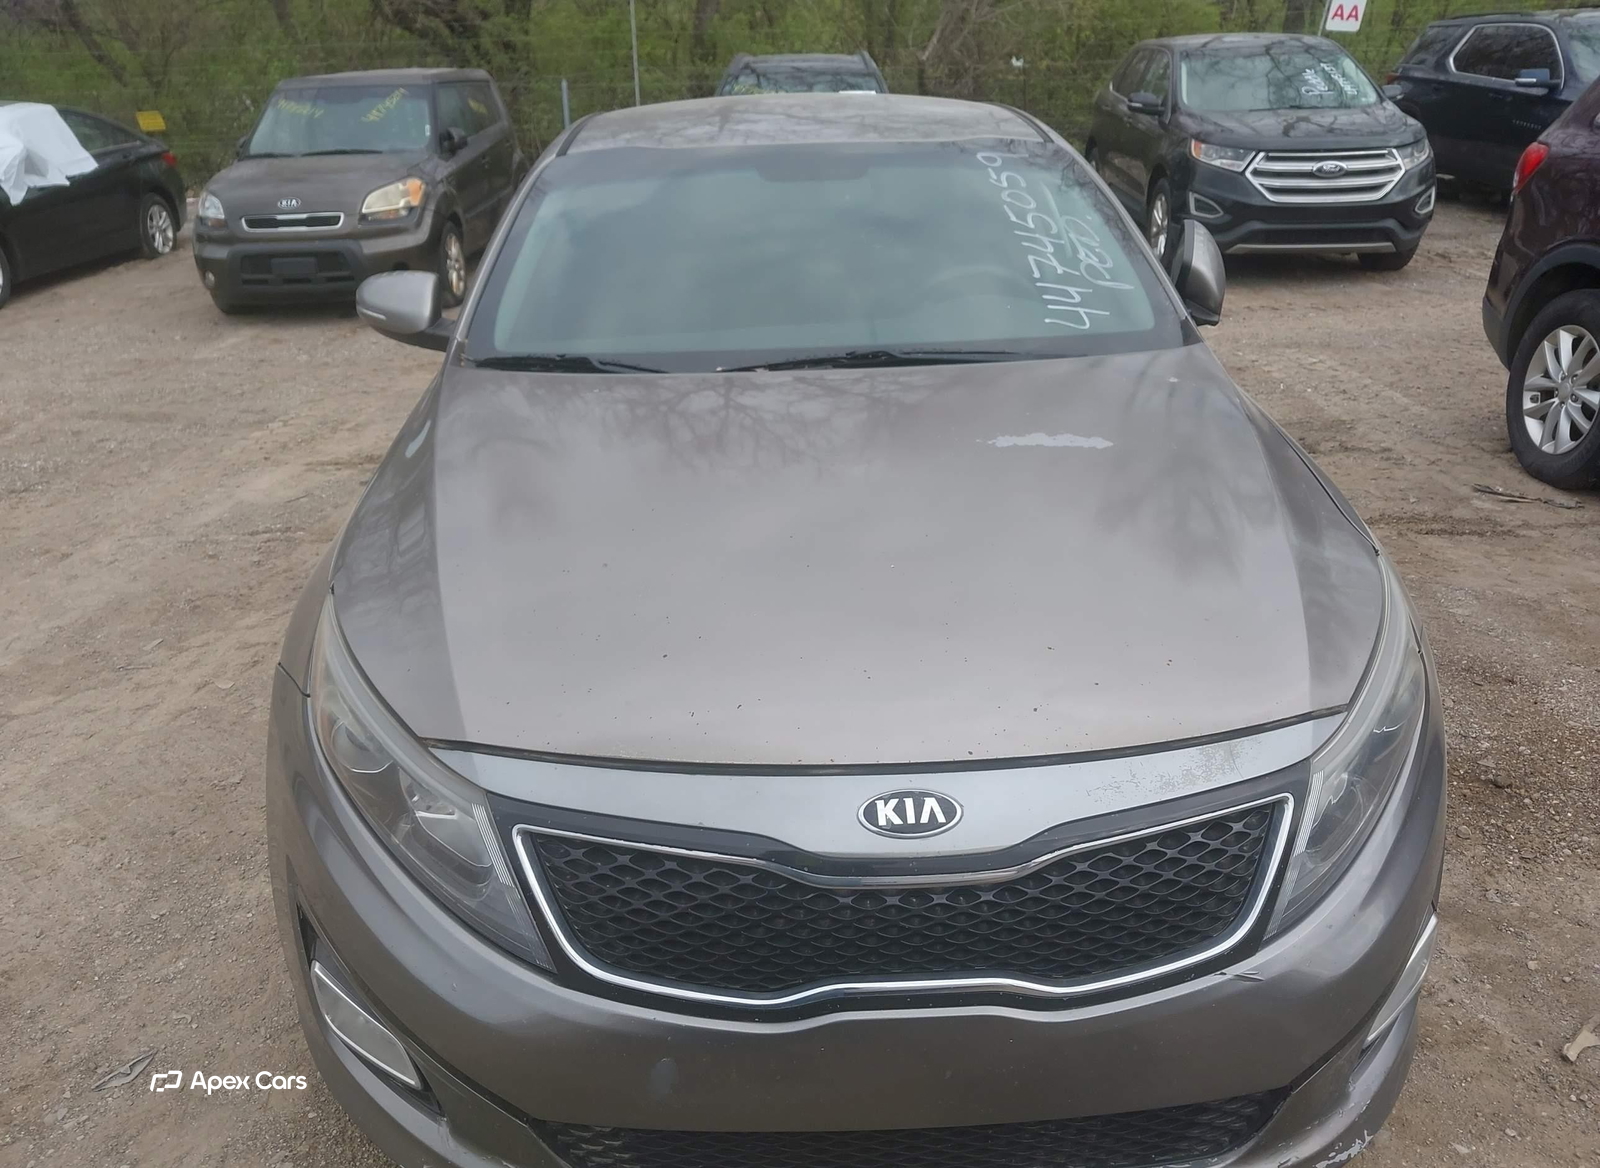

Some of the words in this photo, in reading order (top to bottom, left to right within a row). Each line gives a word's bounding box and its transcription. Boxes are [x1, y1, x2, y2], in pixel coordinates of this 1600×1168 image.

[1331, 4, 1359, 21] AA
[976, 152, 1110, 330] 44745059
[874, 797, 947, 826] KIA
